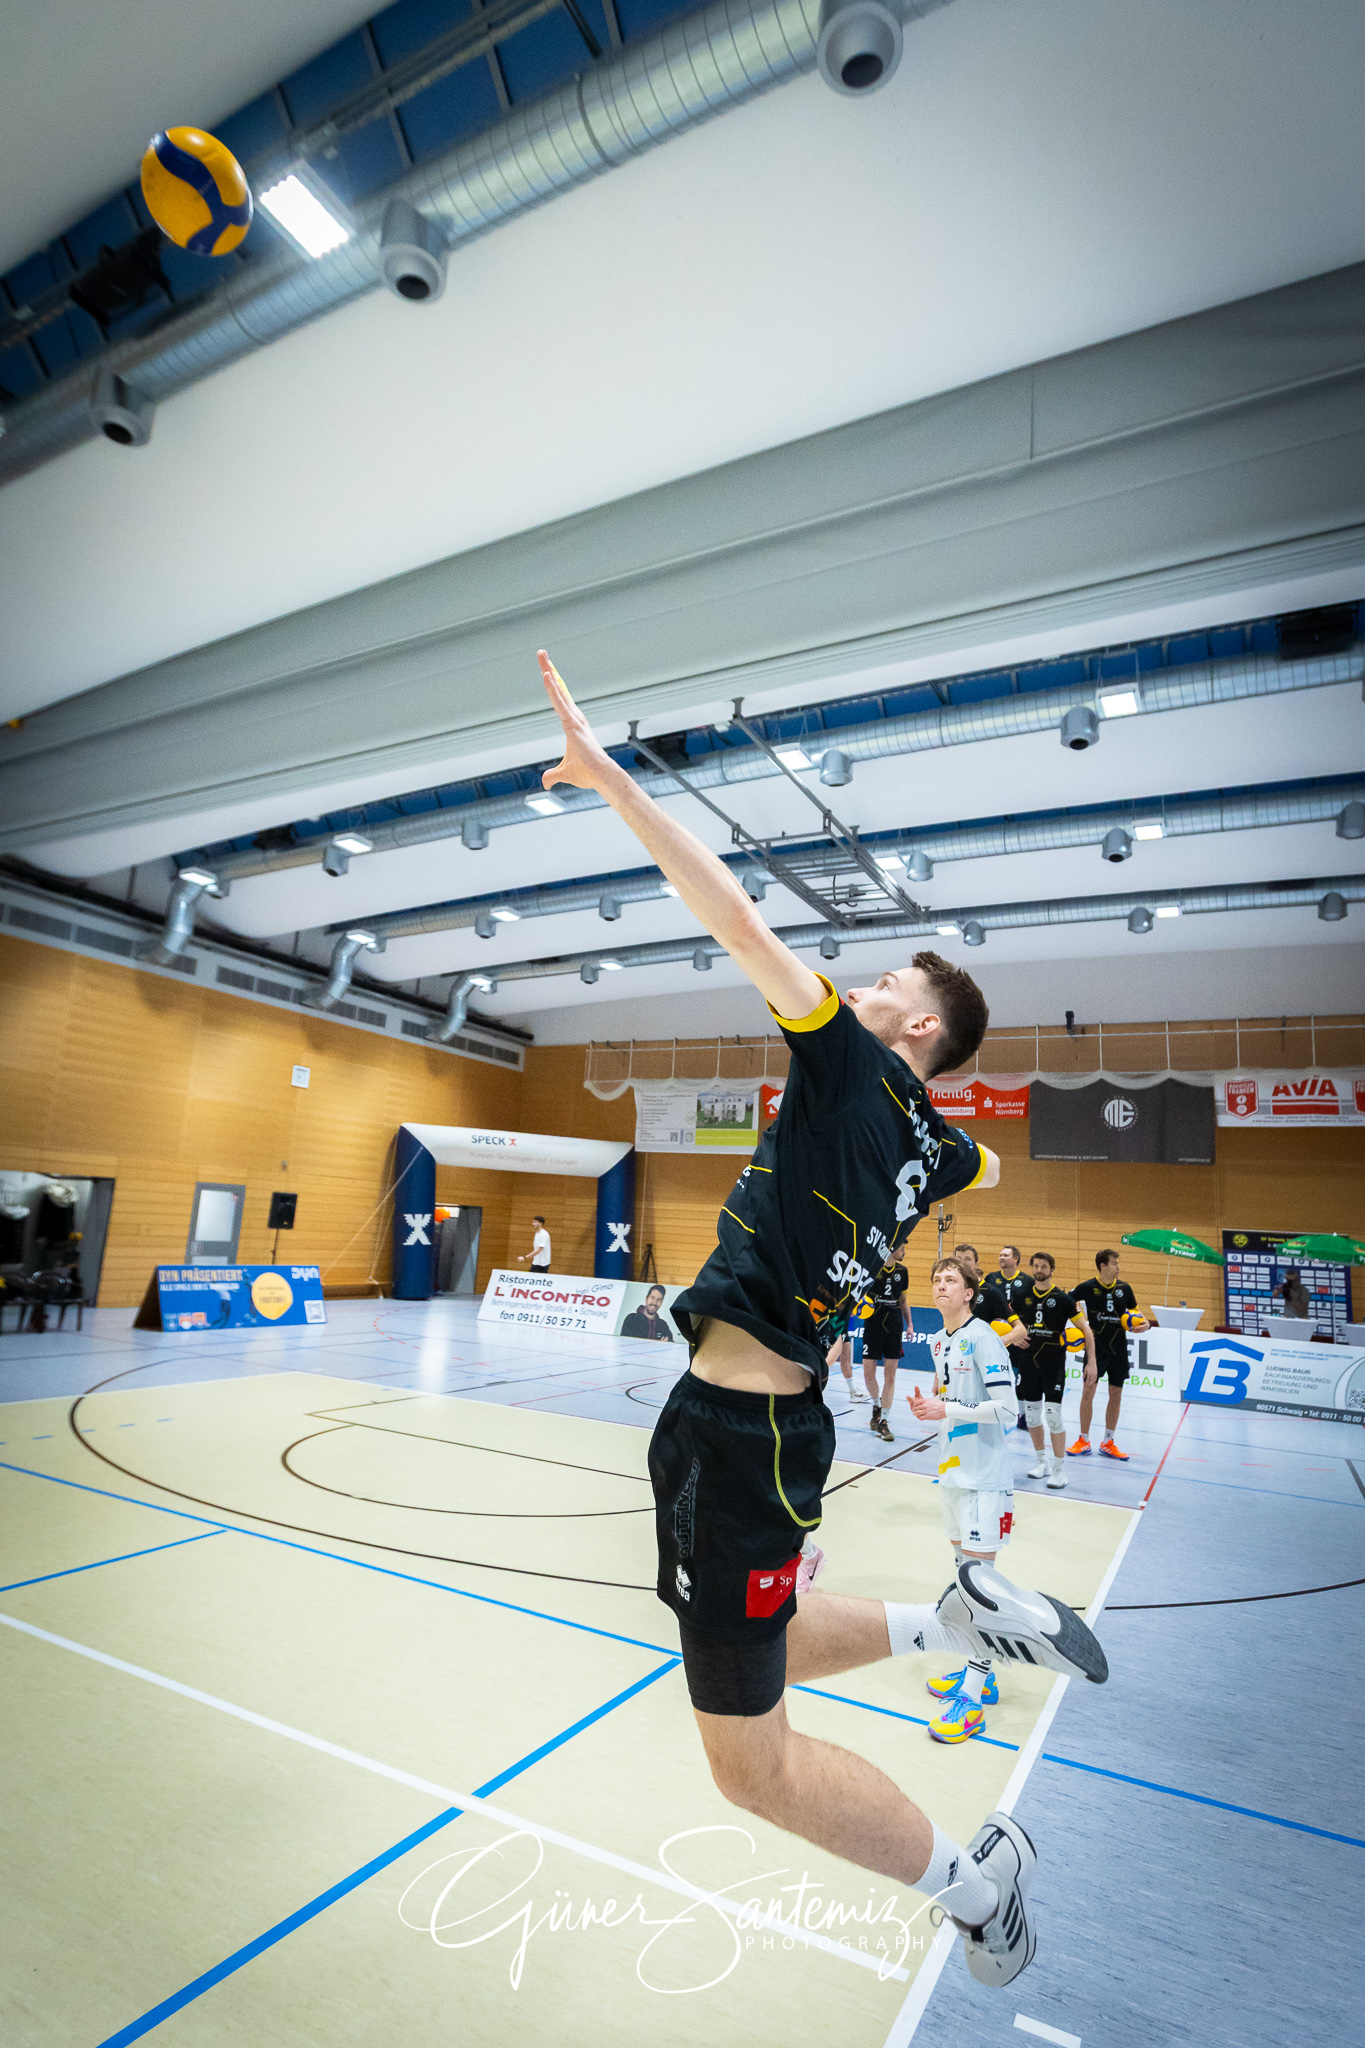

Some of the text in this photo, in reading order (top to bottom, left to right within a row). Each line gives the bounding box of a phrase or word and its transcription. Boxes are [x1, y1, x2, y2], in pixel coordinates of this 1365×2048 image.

[995, 1101, 1025, 1109] Sparkasse
[995, 1108, 1024, 1116] Nürnberg
[471, 1134, 506, 1146] SPECK
[498, 1274, 553, 1287] Ristorante
[591, 1283, 614, 1293] Gino
[884, 1284, 892, 1296] 2
[1005, 1289, 1011, 1300] 1
[1106, 1300, 1114, 1312] 5
[499, 1310, 587, 1329] fon 0911/50 57 71
[1035, 1311, 1043, 1324] 9
[862, 1343, 869, 1355] 2
[1266, 1365, 1291, 1373] LUDWIG
[1262, 1379, 1302, 1389] BETREUUNG
[1260, 1386, 1300, 1395] IMMOBILIEN
[1256, 1403, 1276, 1412] 90571
[1276, 1405, 1304, 1417] Schwaig
[1321, 1411, 1337, 1420] 0911
[1342, 1414, 1352, 1422] 50
